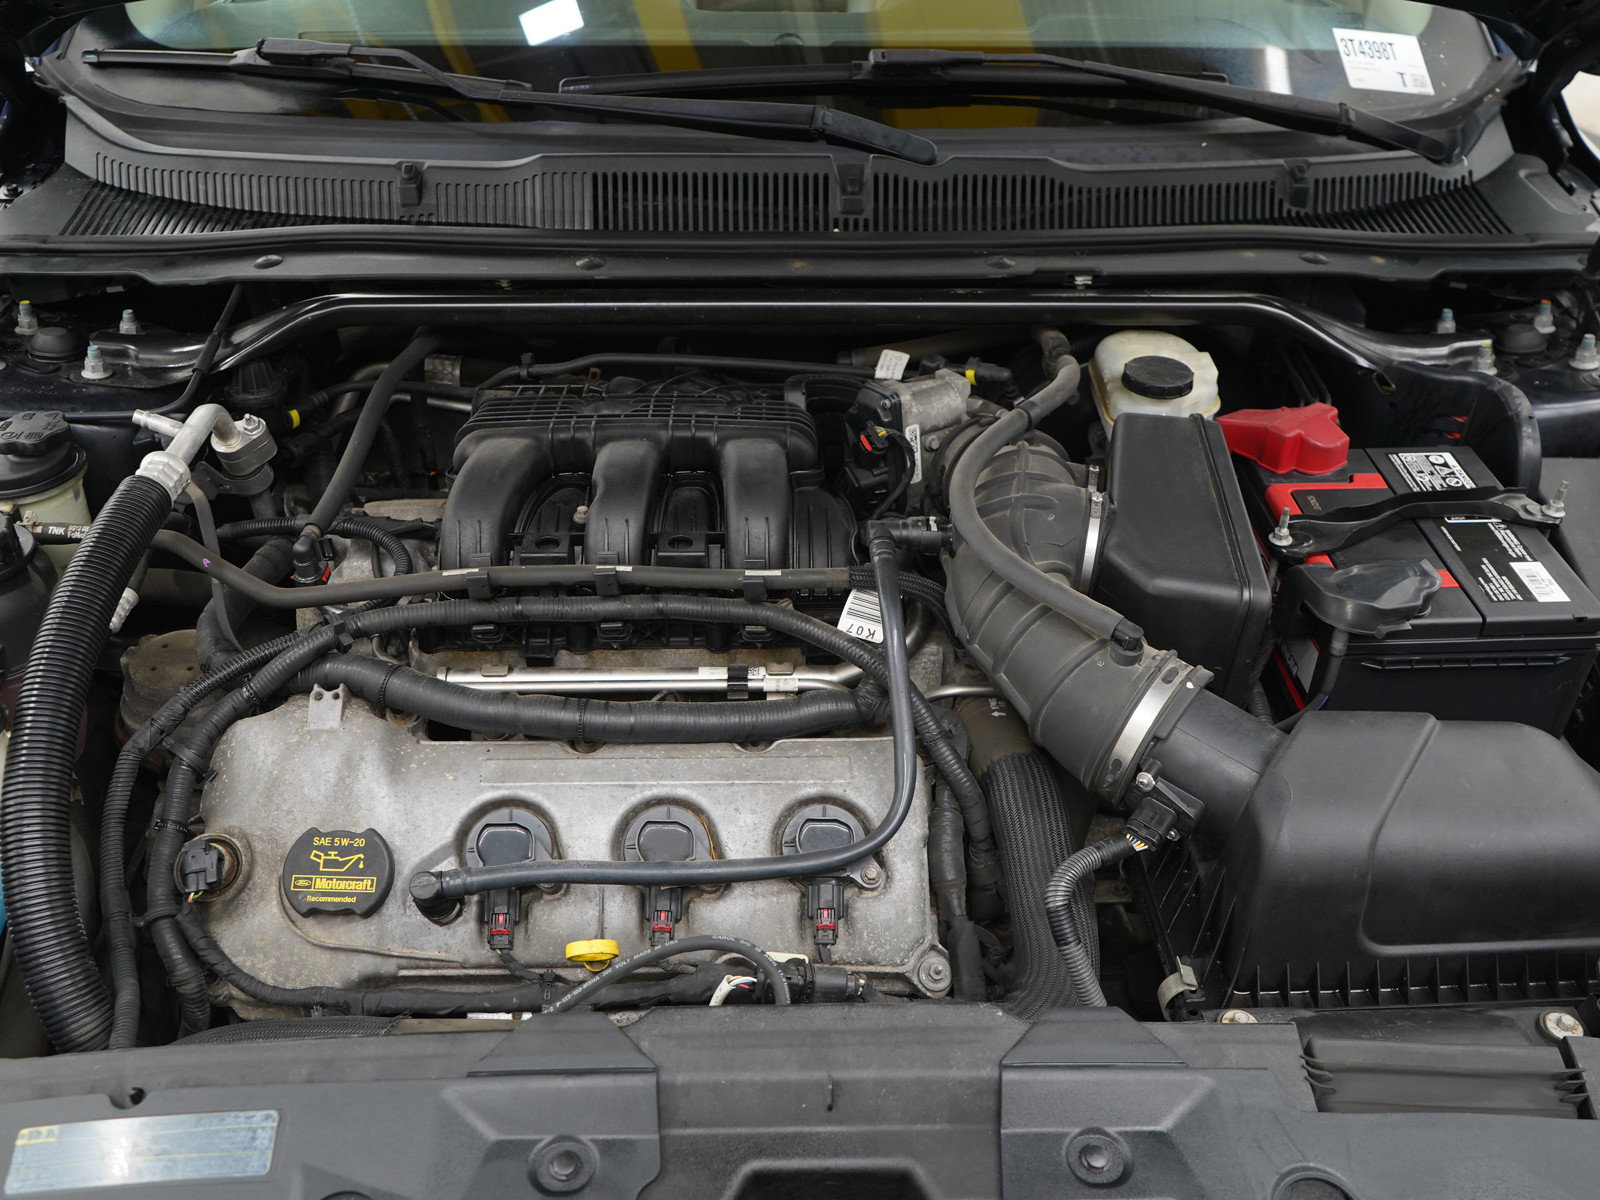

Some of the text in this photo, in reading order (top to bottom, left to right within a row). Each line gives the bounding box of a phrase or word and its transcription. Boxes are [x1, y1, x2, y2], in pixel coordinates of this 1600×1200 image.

[1340, 37, 1397, 61] 3T4398T
[1396, 71, 1407, 88] T
[48, 525, 66, 536] TNK
[846, 623, 876, 640] K07
[313, 837, 366, 847] SAE 5W-20
[306, 895, 357, 903] Recommended
[615, 957, 631, 969] VOLT
[633, 947, 652, 960] MADE
[665, 939, 679, 947] USA
